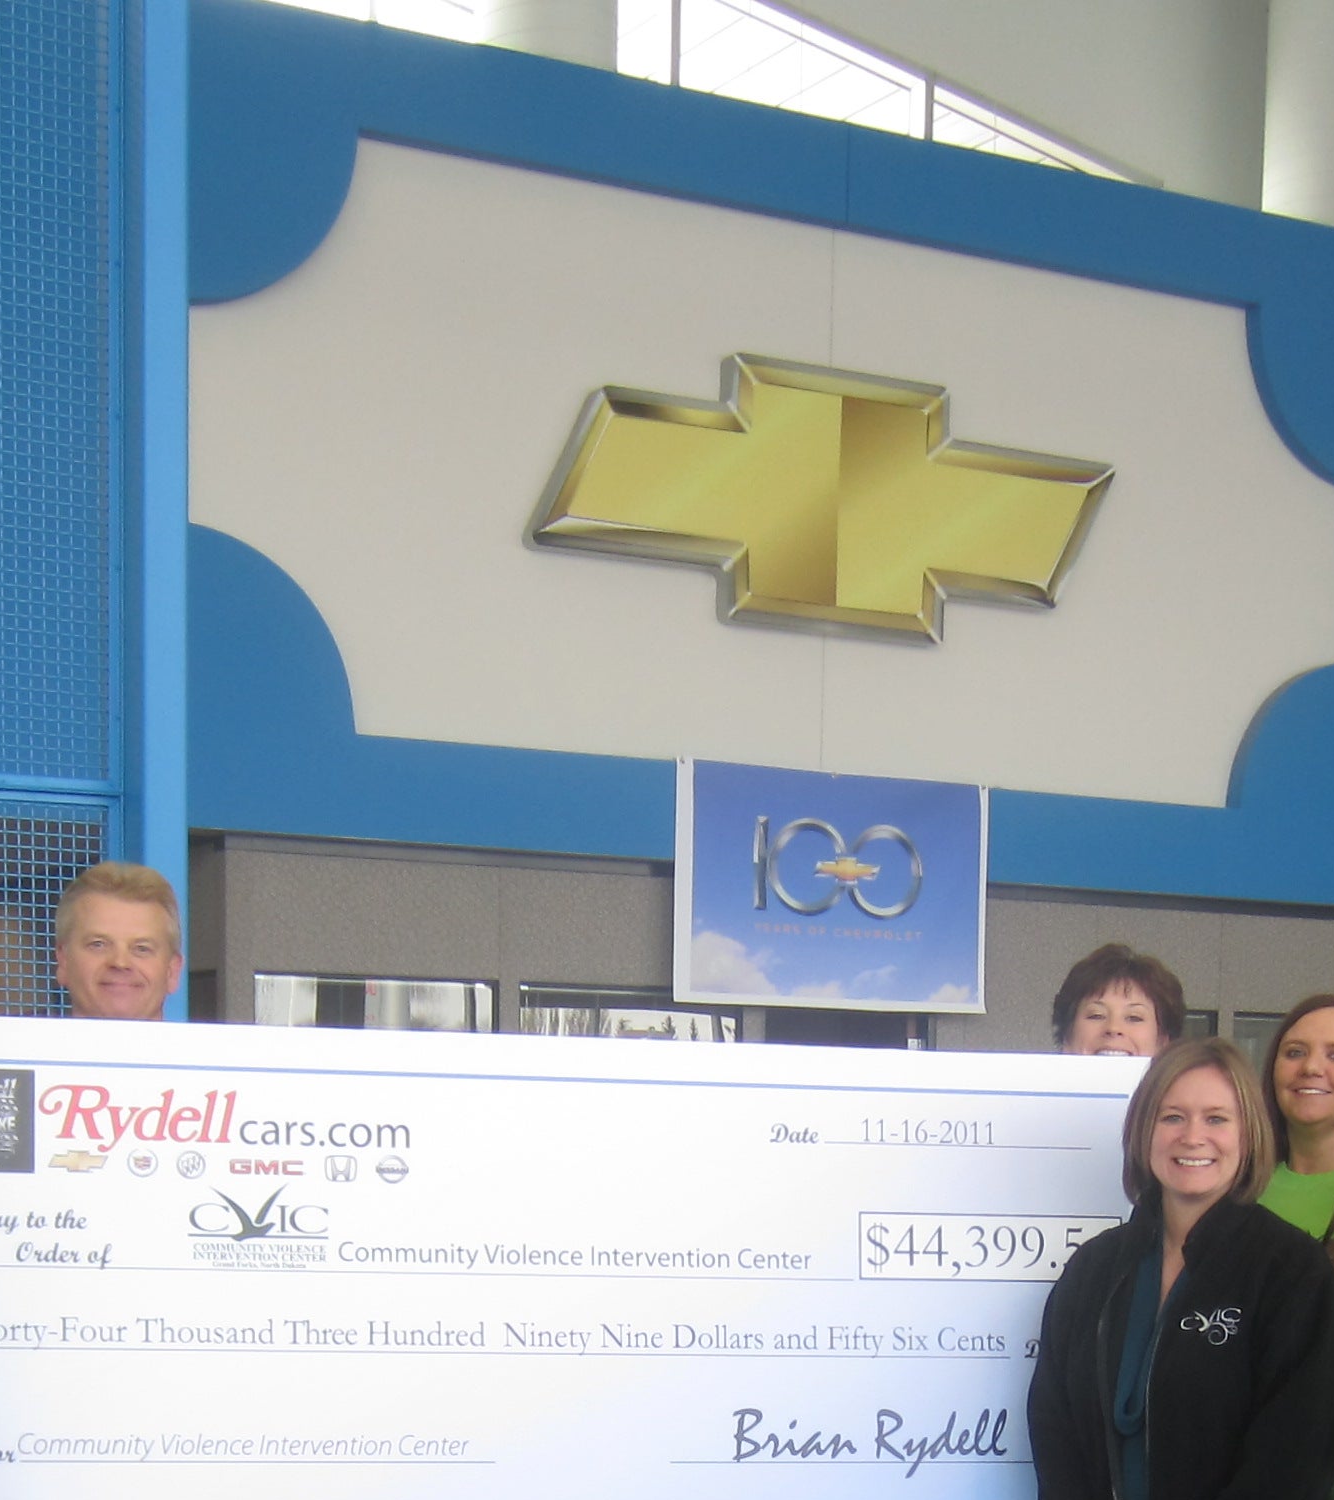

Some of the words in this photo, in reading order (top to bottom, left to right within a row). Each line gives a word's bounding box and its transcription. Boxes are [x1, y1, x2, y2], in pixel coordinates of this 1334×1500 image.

[753, 815, 923, 919] 100
[770, 1123, 819, 1145] Date
[861, 1118, 996, 1145] 11-16-2011
[229, 1159, 304, 1176] GMC
[26, 1210, 47, 1230] to
[54, 1209, 87, 1230] the
[16, 1242, 80, 1264] Order
[88, 1243, 113, 1270] of
[193, 1242, 265, 1253] COMMUNITY
[269, 1244, 326, 1255] VIOLENCE
[193, 1252, 279, 1262] INTERVENTION
[281, 1253, 326, 1263] CENTER
[338, 1241, 478, 1269] Community
[484, 1244, 583, 1266] Violence
[591, 1246, 730, 1268] Intervention
[738, 1248, 811, 1270] Center
[136, 1317, 275, 1345] Thousand
[283, 1319, 357, 1346] Three
[368, 1320, 485, 1348] Hundred
[504, 1322, 591, 1354] Ninety
[600, 1324, 663, 1349] Nine
[673, 1324, 764, 1350] Dollars
[774, 1325, 818, 1351] and
[827, 1326, 884, 1357] Fifty
[893, 1327, 929, 1352] Six
[938, 1327, 1006, 1352] Cents
[17, 1433, 155, 1461] Community
[161, 1433, 254, 1457] Violence
[259, 1435, 392, 1457] Intervention
[399, 1435, 469, 1457] Center
[732, 1408, 857, 1461] Brian
[875, 1408, 1008, 1478] Rydell
